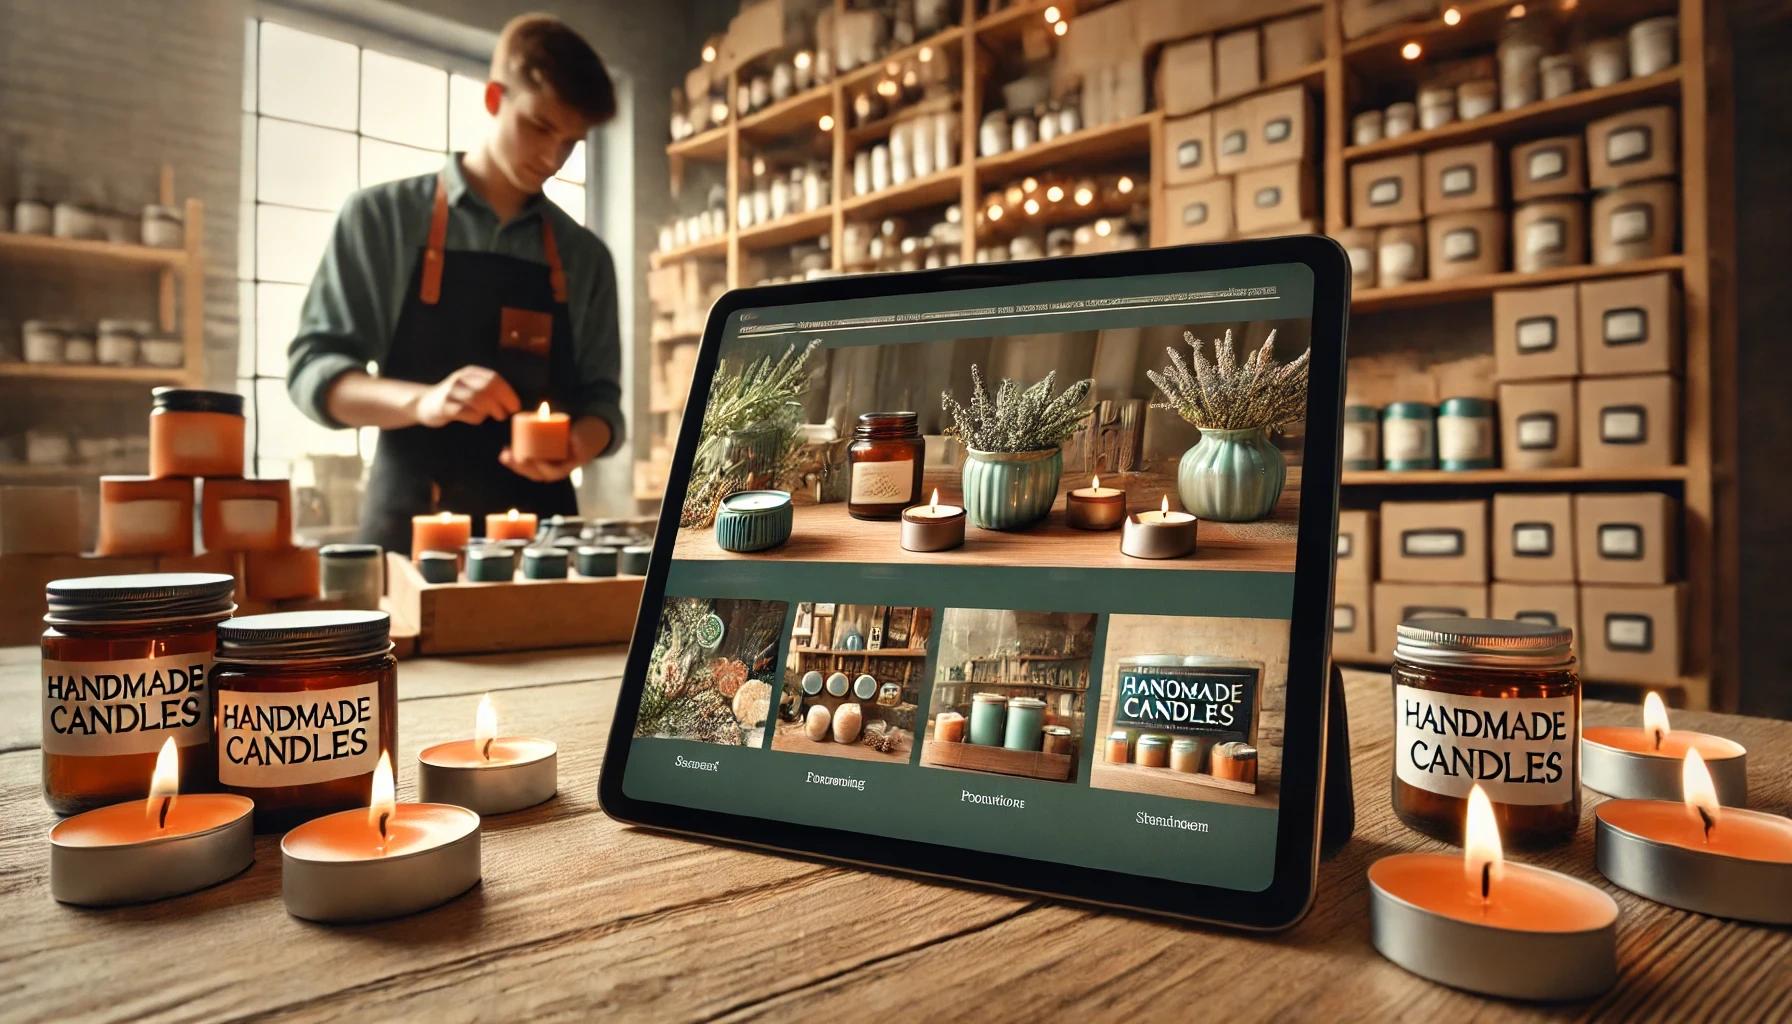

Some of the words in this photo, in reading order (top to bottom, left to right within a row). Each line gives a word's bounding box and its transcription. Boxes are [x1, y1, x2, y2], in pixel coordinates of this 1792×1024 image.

[48, 664, 204, 701] HANDMADE
[51, 696, 200, 734] CANDLES
[224, 697, 371, 734] HANDMADE
[1124, 697, 1234, 726] CANDLES
[1406, 699, 1566, 740] HANDMADE
[226, 727, 368, 766] CANDLES
[1411, 740, 1563, 784] CANDLES
